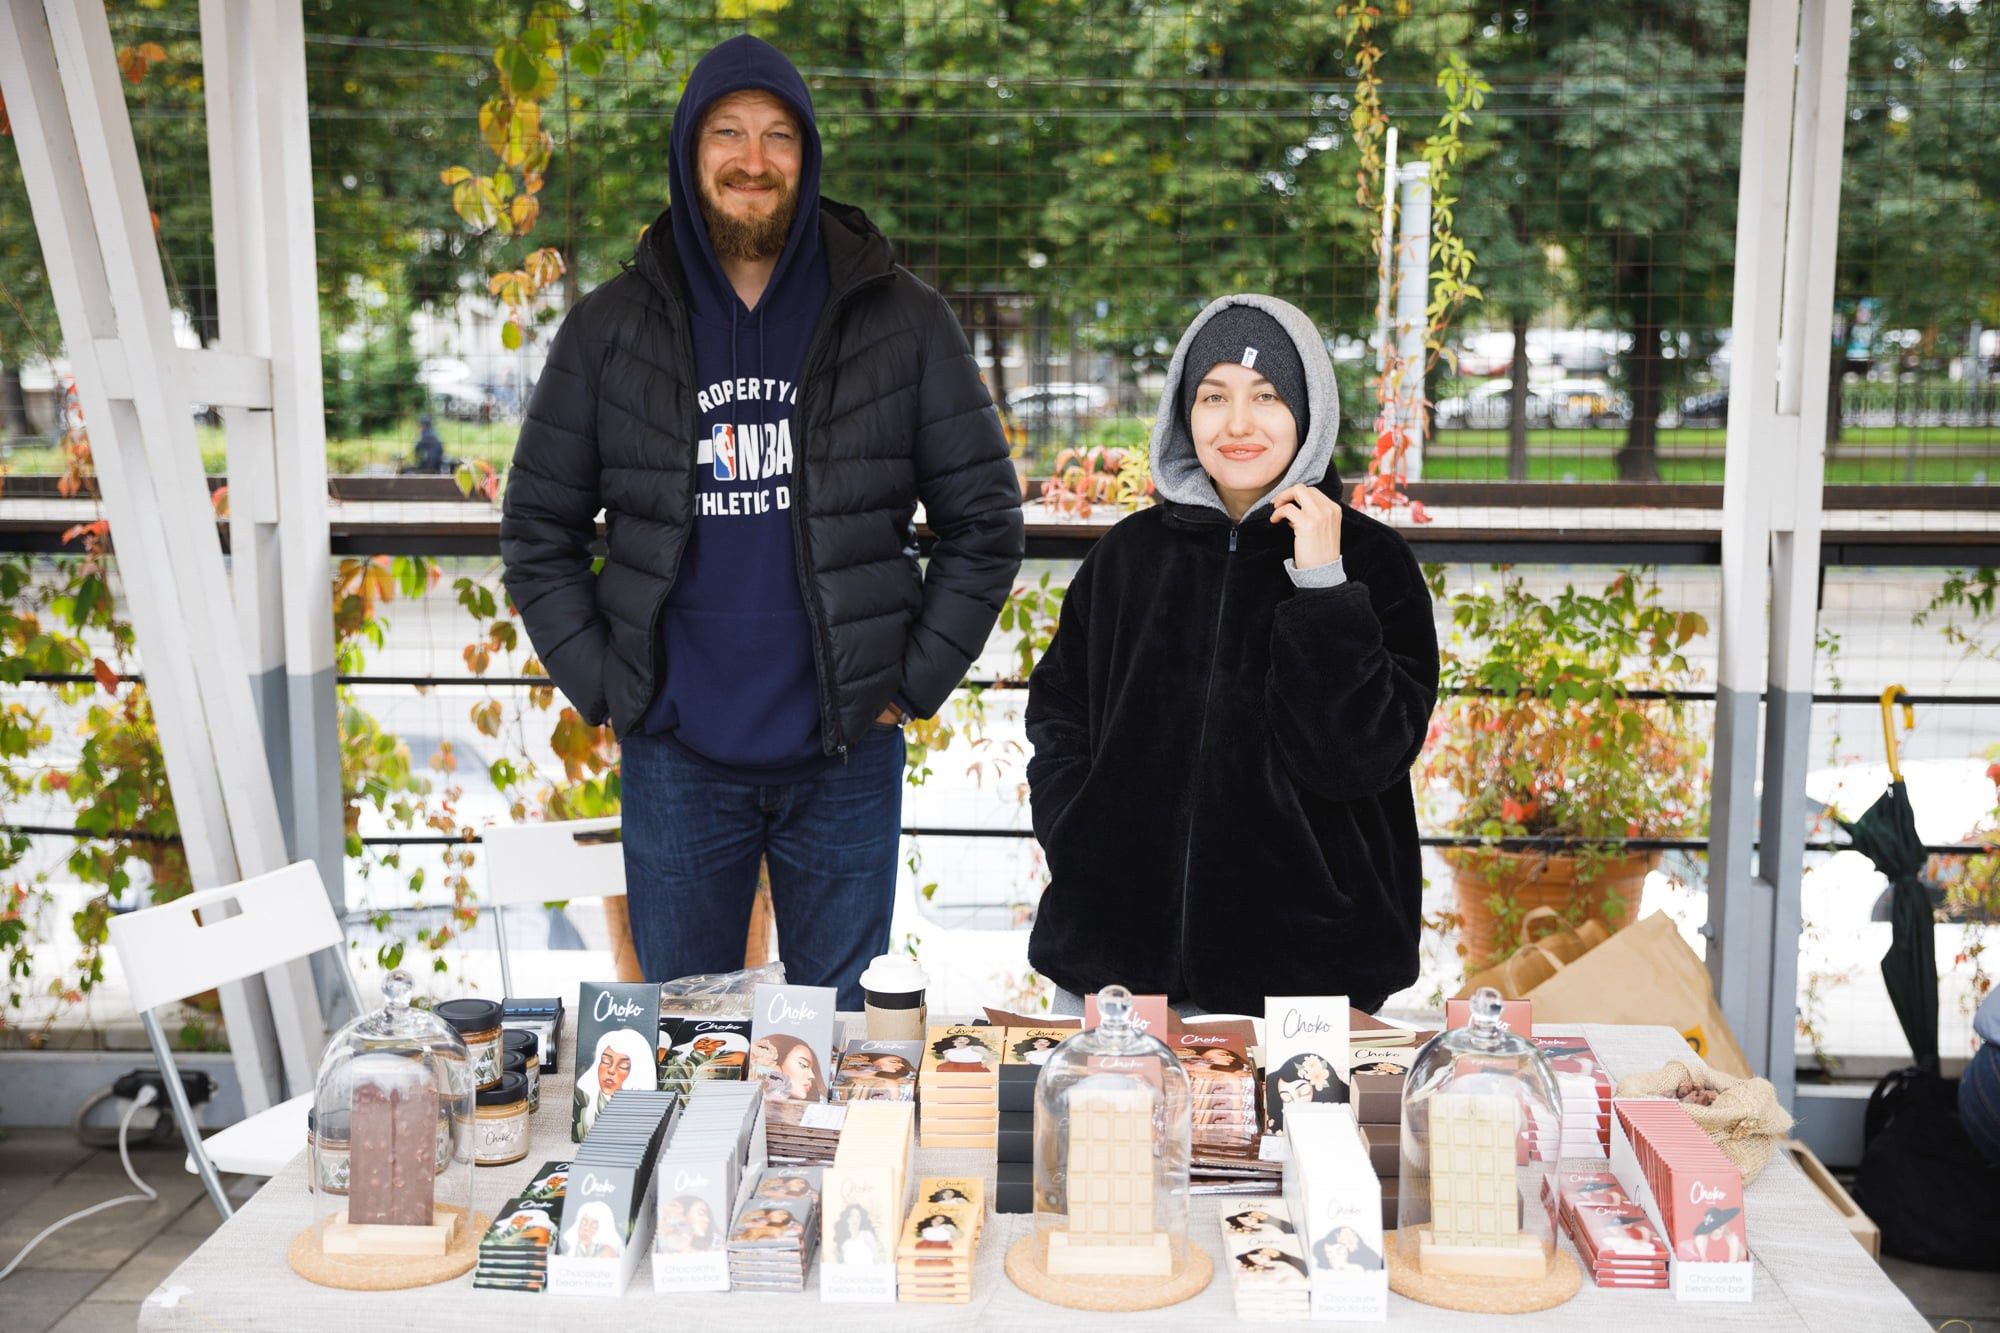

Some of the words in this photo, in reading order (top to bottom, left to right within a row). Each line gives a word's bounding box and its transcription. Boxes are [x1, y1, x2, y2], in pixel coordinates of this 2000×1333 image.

[697, 377, 792, 414] ROPERTY
[737, 418, 793, 481] NBA
[695, 489, 770, 516] THLETIC
[776, 486, 790, 510] D
[593, 990, 645, 1022] Choko
[767, 993, 818, 1024] Choko
[694, 1021, 743, 1031] Choko
[1283, 1008, 1333, 1039] Choko
[860, 1040, 909, 1051] Choko
[1181, 1034, 1229, 1045] Choko
[1355, 1049, 1400, 1059] Choko
[1690, 1181, 1726, 1204] Choko
